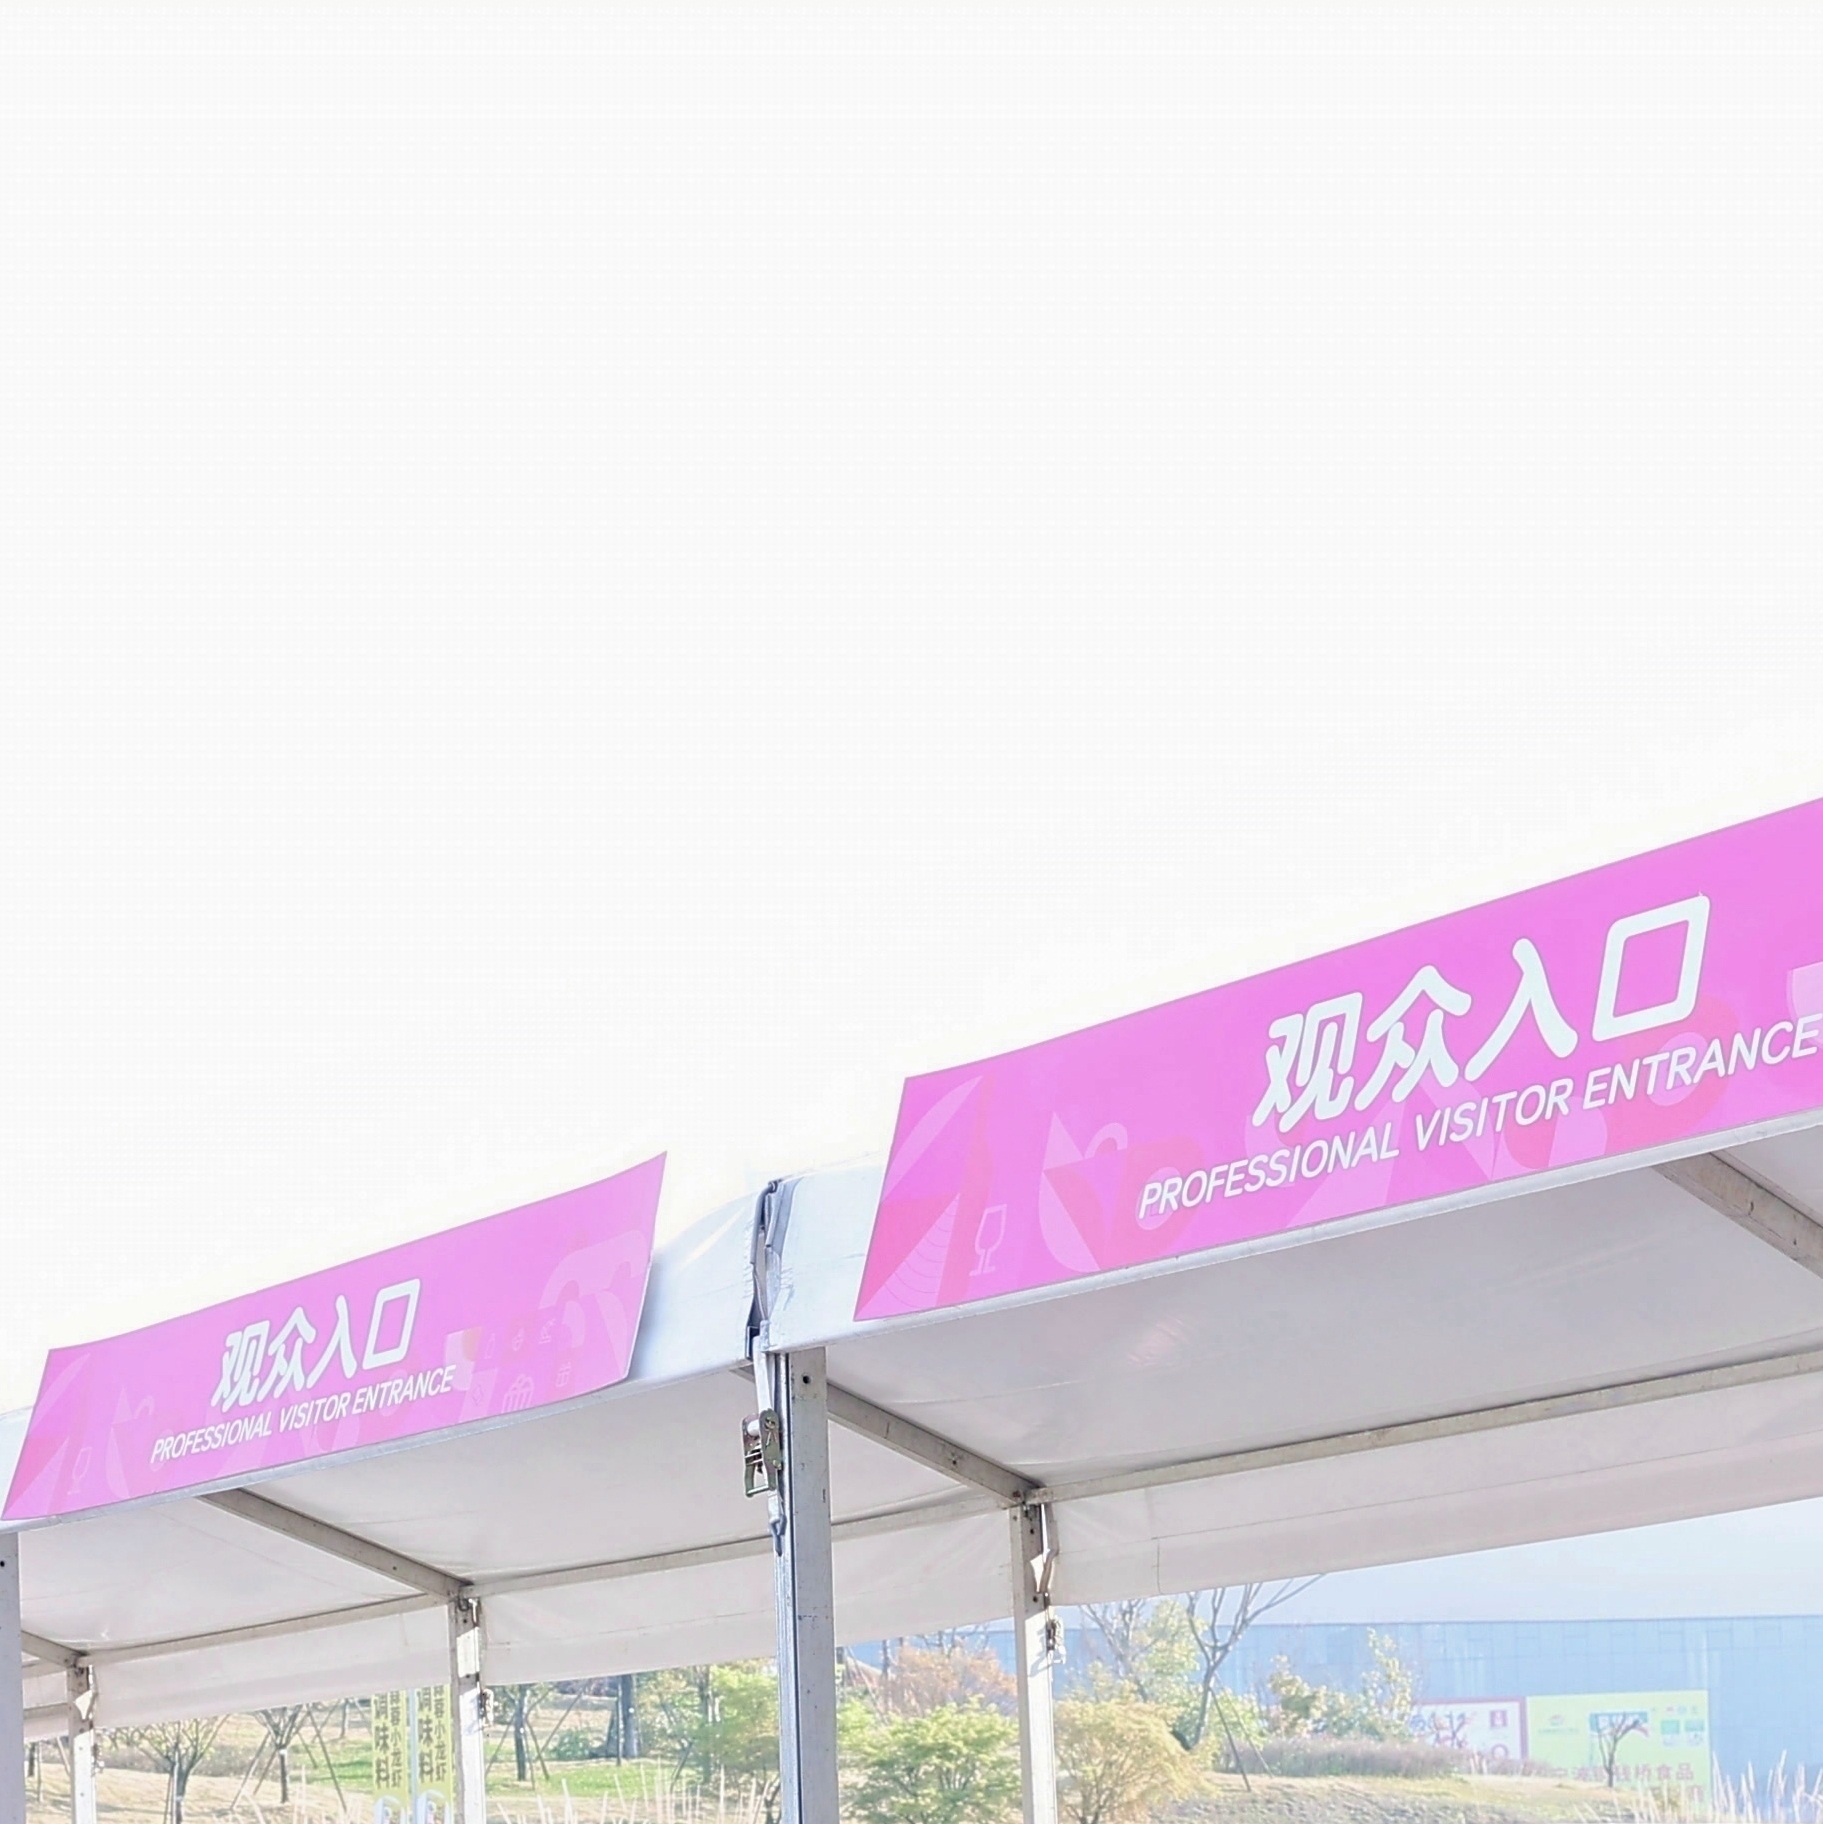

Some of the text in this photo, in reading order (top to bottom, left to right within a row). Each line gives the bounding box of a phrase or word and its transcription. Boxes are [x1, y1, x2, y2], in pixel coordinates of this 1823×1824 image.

[1251, 894, 1711, 1131] 观众入口
[1136, 1015, 1823, 1221] PROFESSIONAL VISITOR ENTRANCE
[149, 1364, 457, 1464] PROFESSIONAL VISITOR ENTRANCE
[211, 1278, 422, 1412] 观众入口
